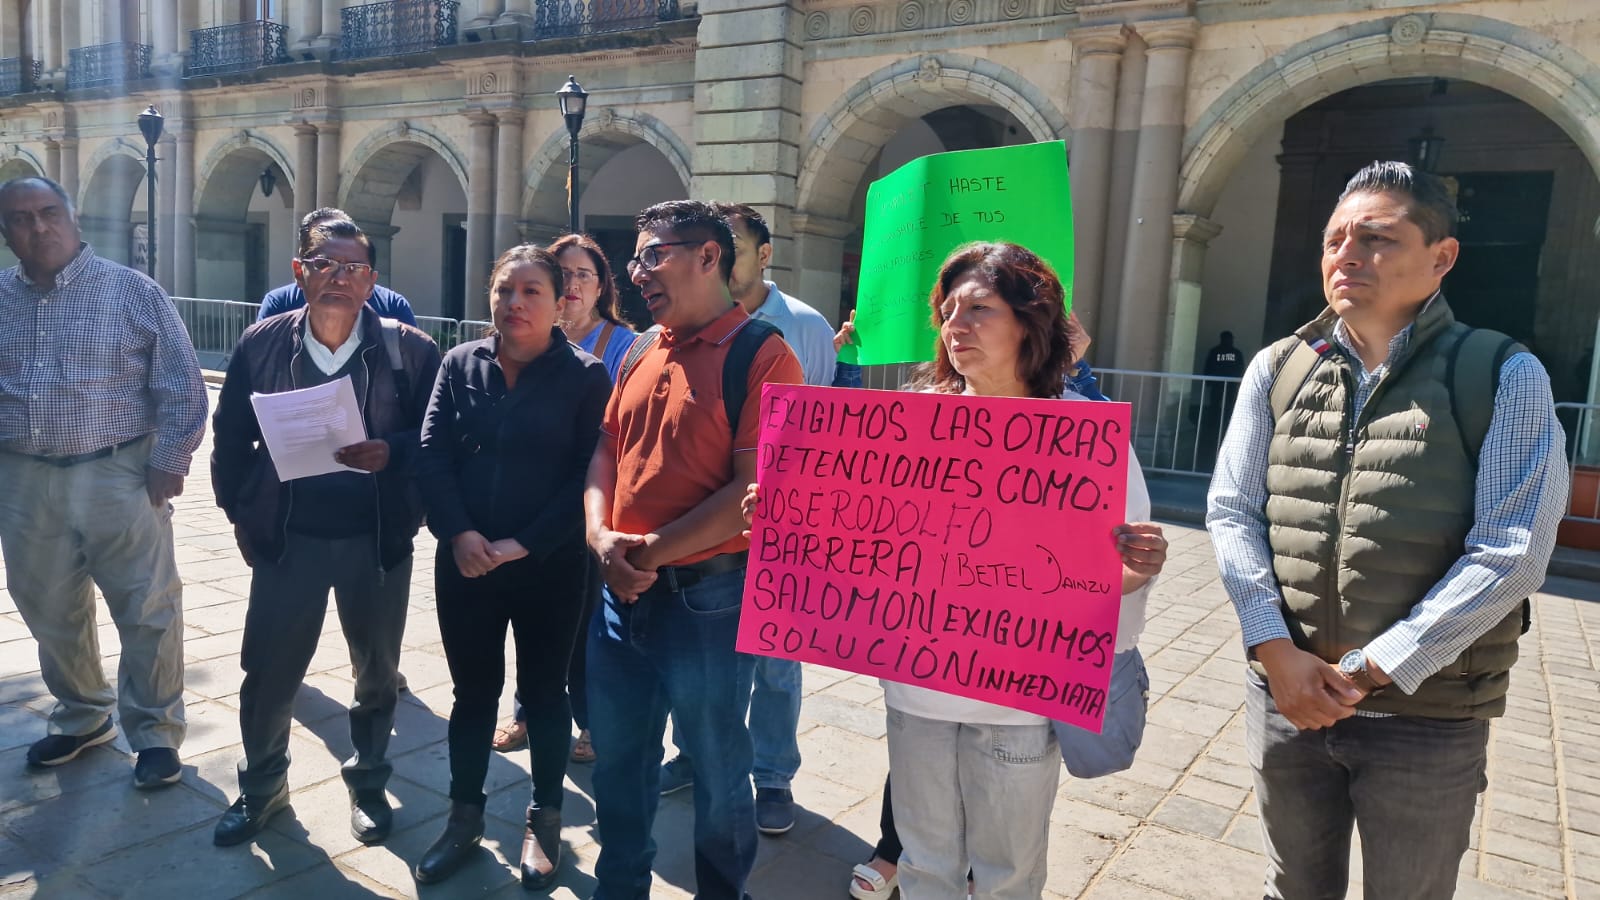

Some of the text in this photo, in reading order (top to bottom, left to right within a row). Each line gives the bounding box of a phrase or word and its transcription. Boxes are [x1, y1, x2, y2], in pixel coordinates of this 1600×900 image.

[950, 176, 1007, 195] HASTE
[941, 212, 960, 227] DE
[973, 210, 1005, 224] TUS
[766, 395, 1122, 468] EXIGIMOS LAS OTRAS
[761, 442, 1114, 512] DETENCIONES COMO:
[830, 489, 993, 549] RODOLFO
[759, 527, 922, 587] BARRERA
[956, 552, 1033, 591] BETEL
[752, 568, 1113, 669] SALOMON EXIGUIMOS
[976, 667, 1107, 719] INMEDIATA
